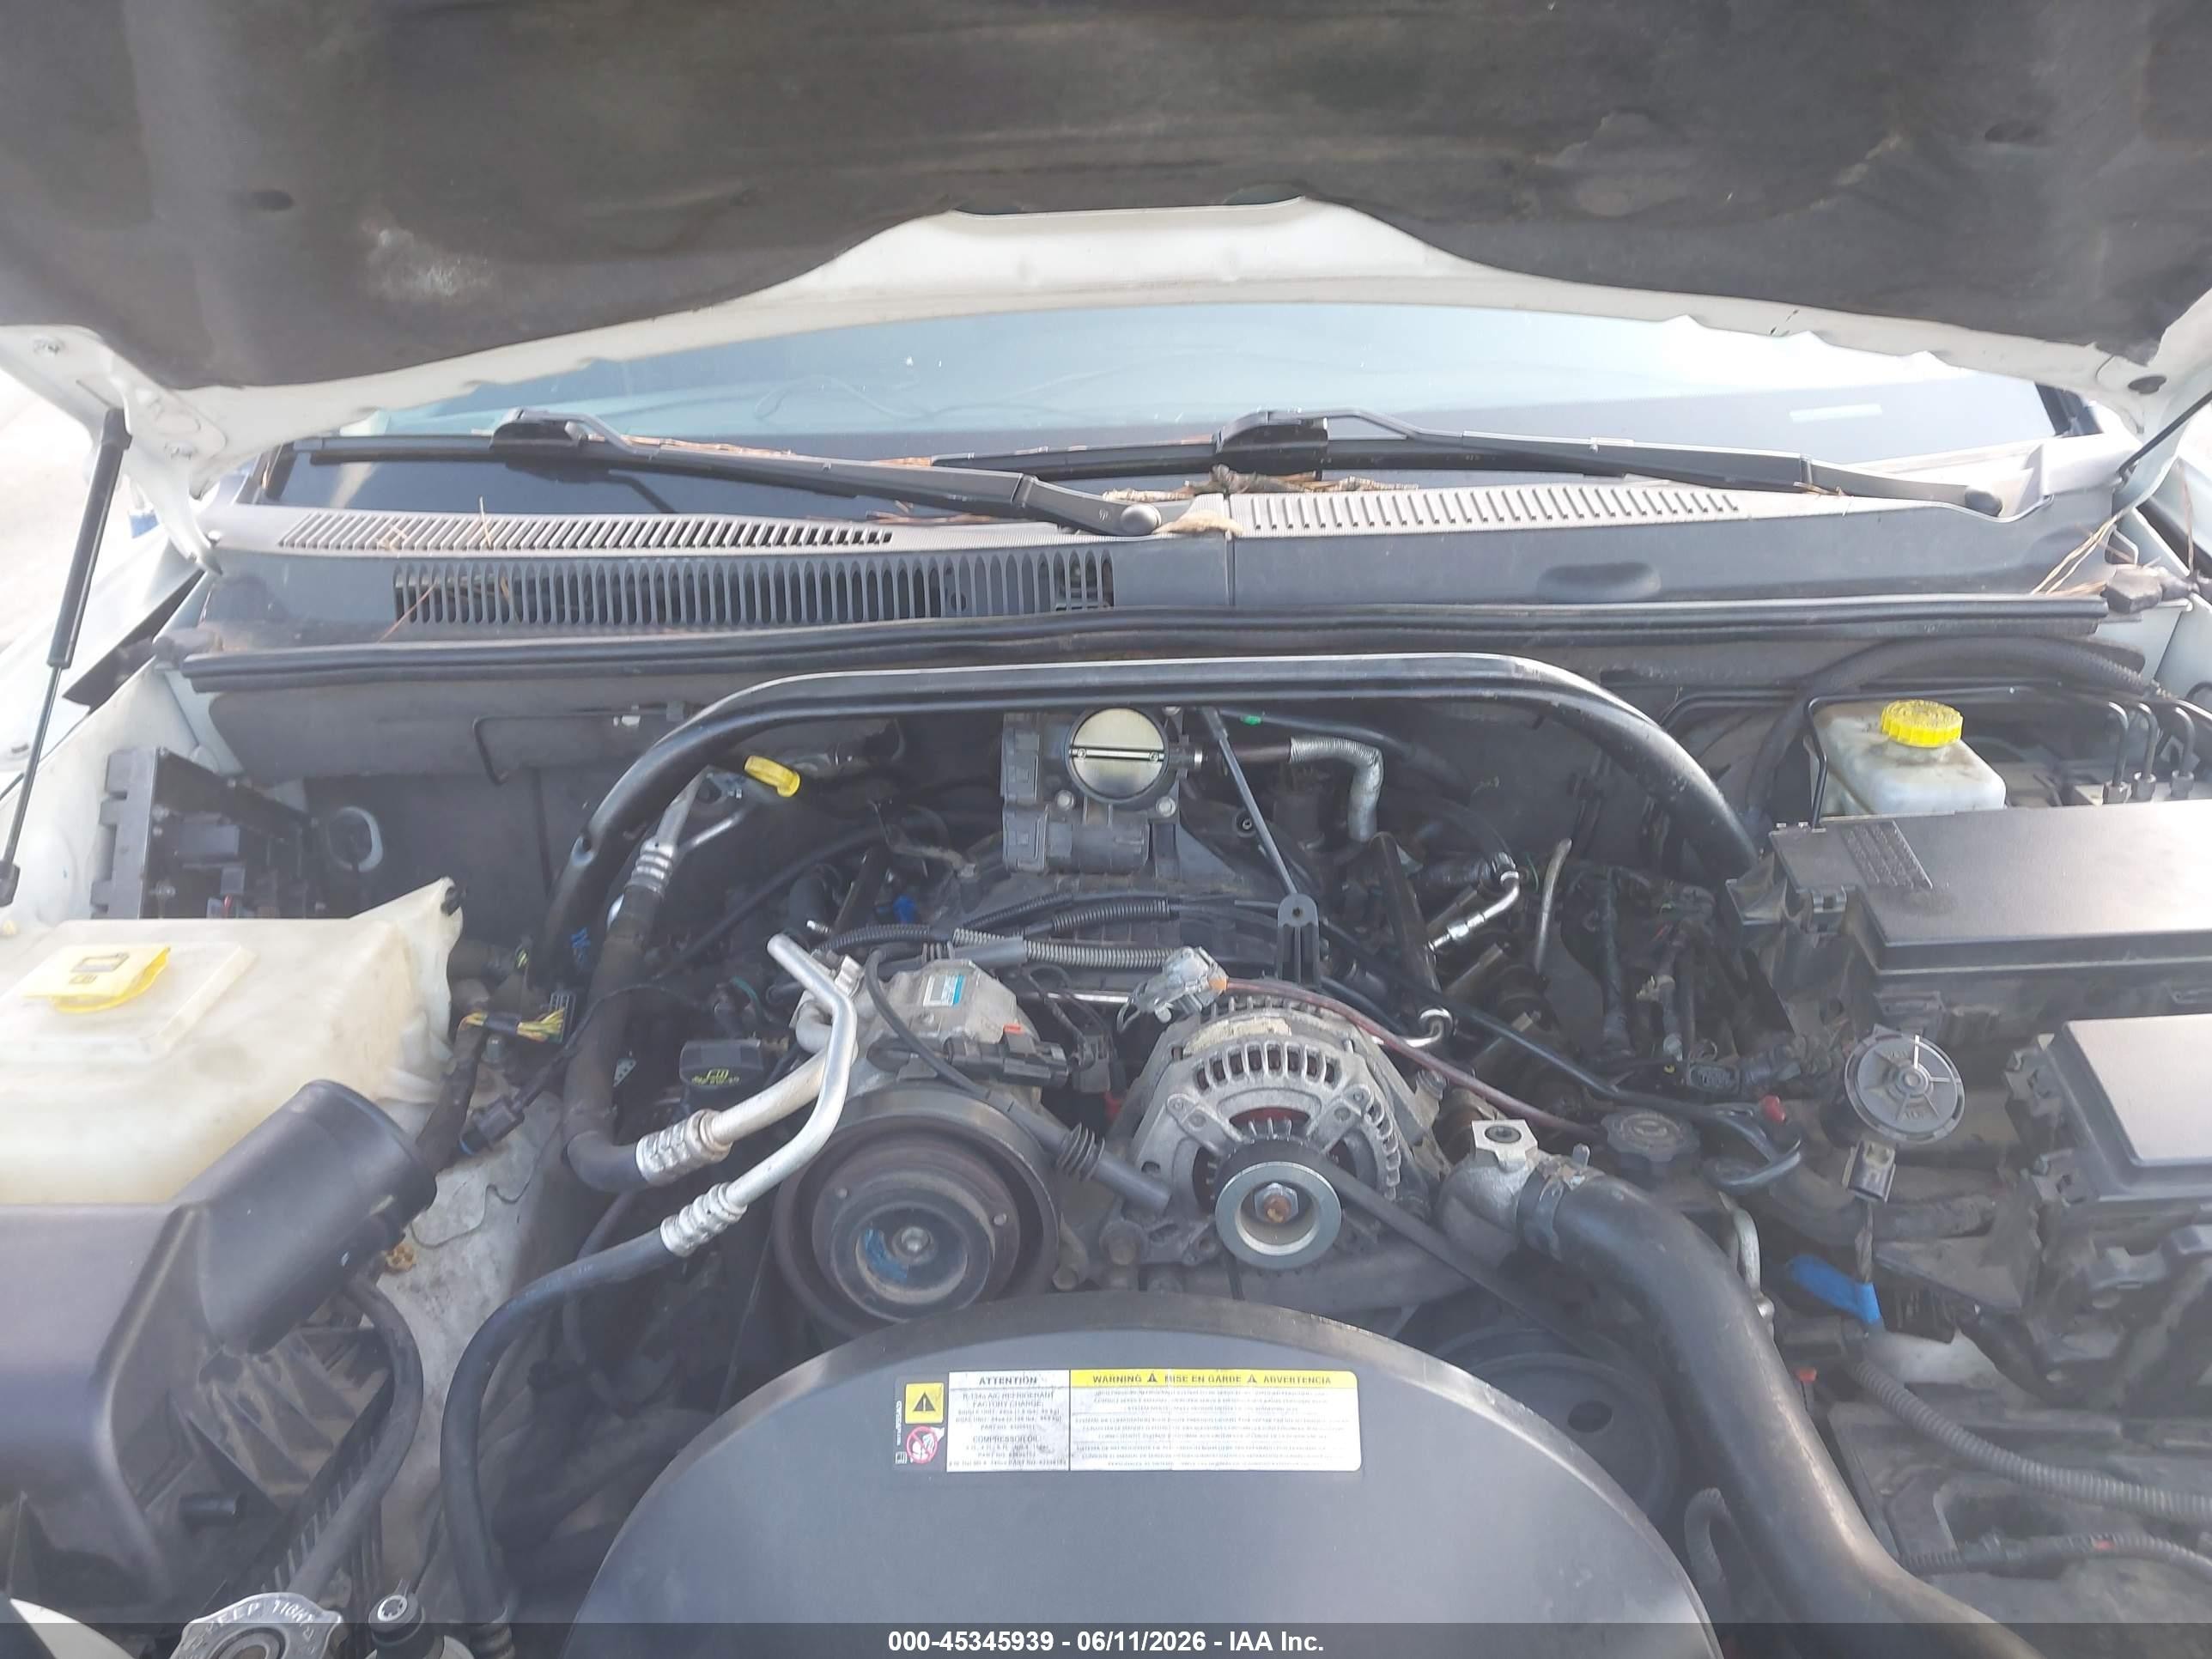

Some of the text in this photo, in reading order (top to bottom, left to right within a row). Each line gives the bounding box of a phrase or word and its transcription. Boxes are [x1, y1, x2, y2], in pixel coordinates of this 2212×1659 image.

[979, 1376, 1037, 1385] ATTENTION
[1093, 1374, 1332, 1384] WARNING MISE EN GARDE ADVERTENCIA
